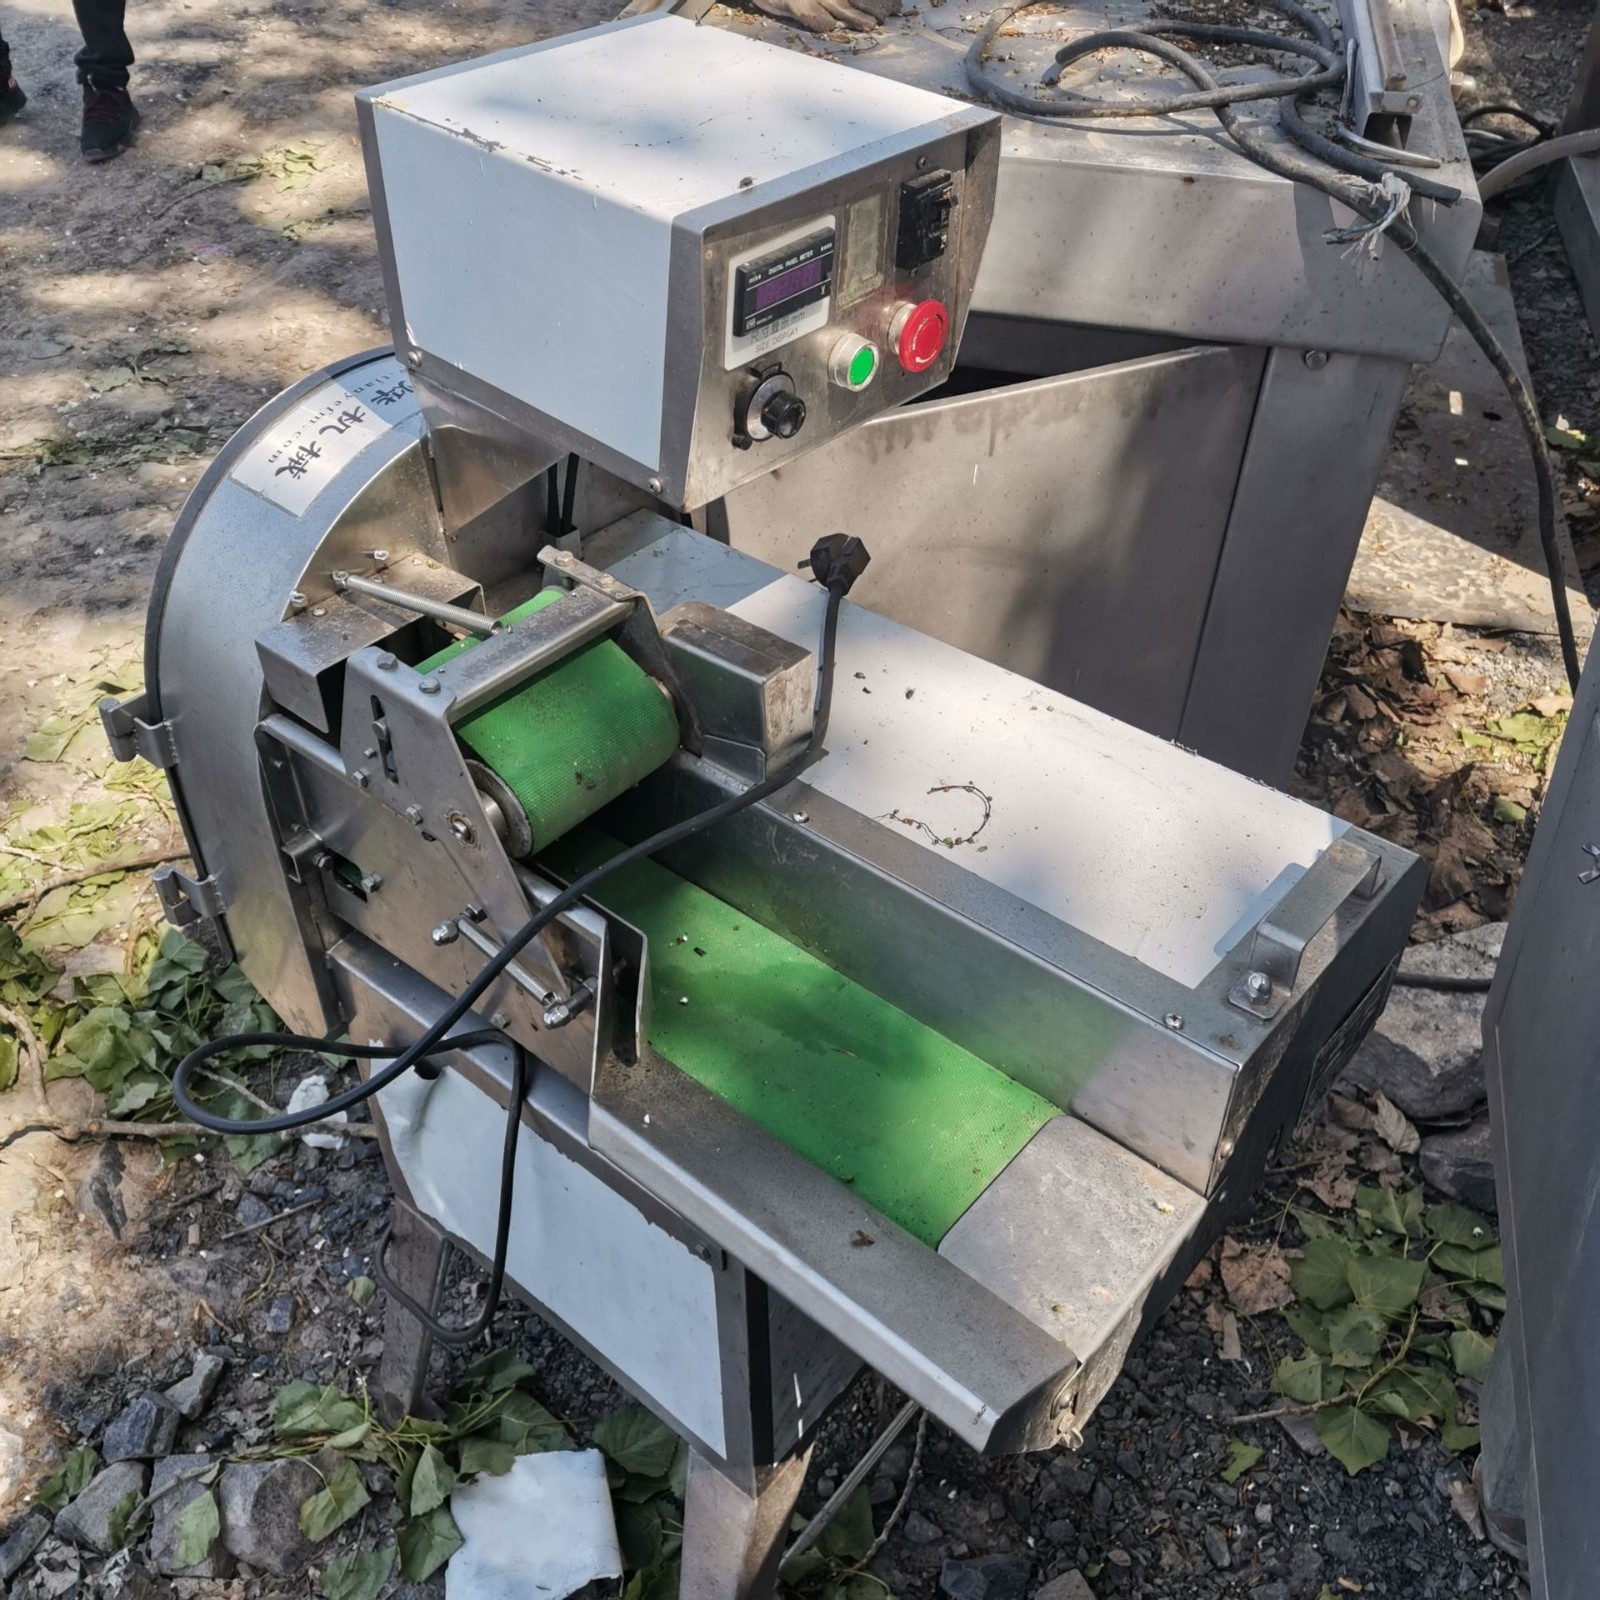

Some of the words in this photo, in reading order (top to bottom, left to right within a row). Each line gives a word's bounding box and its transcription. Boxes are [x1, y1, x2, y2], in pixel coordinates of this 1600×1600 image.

[768, 263, 784, 275] DIGITAL
[785, 257, 798, 267] PANEL
[799, 249, 814, 261] METER
[755, 339, 770, 353] SIZE
[772, 327, 799, 345] DISPLAY
